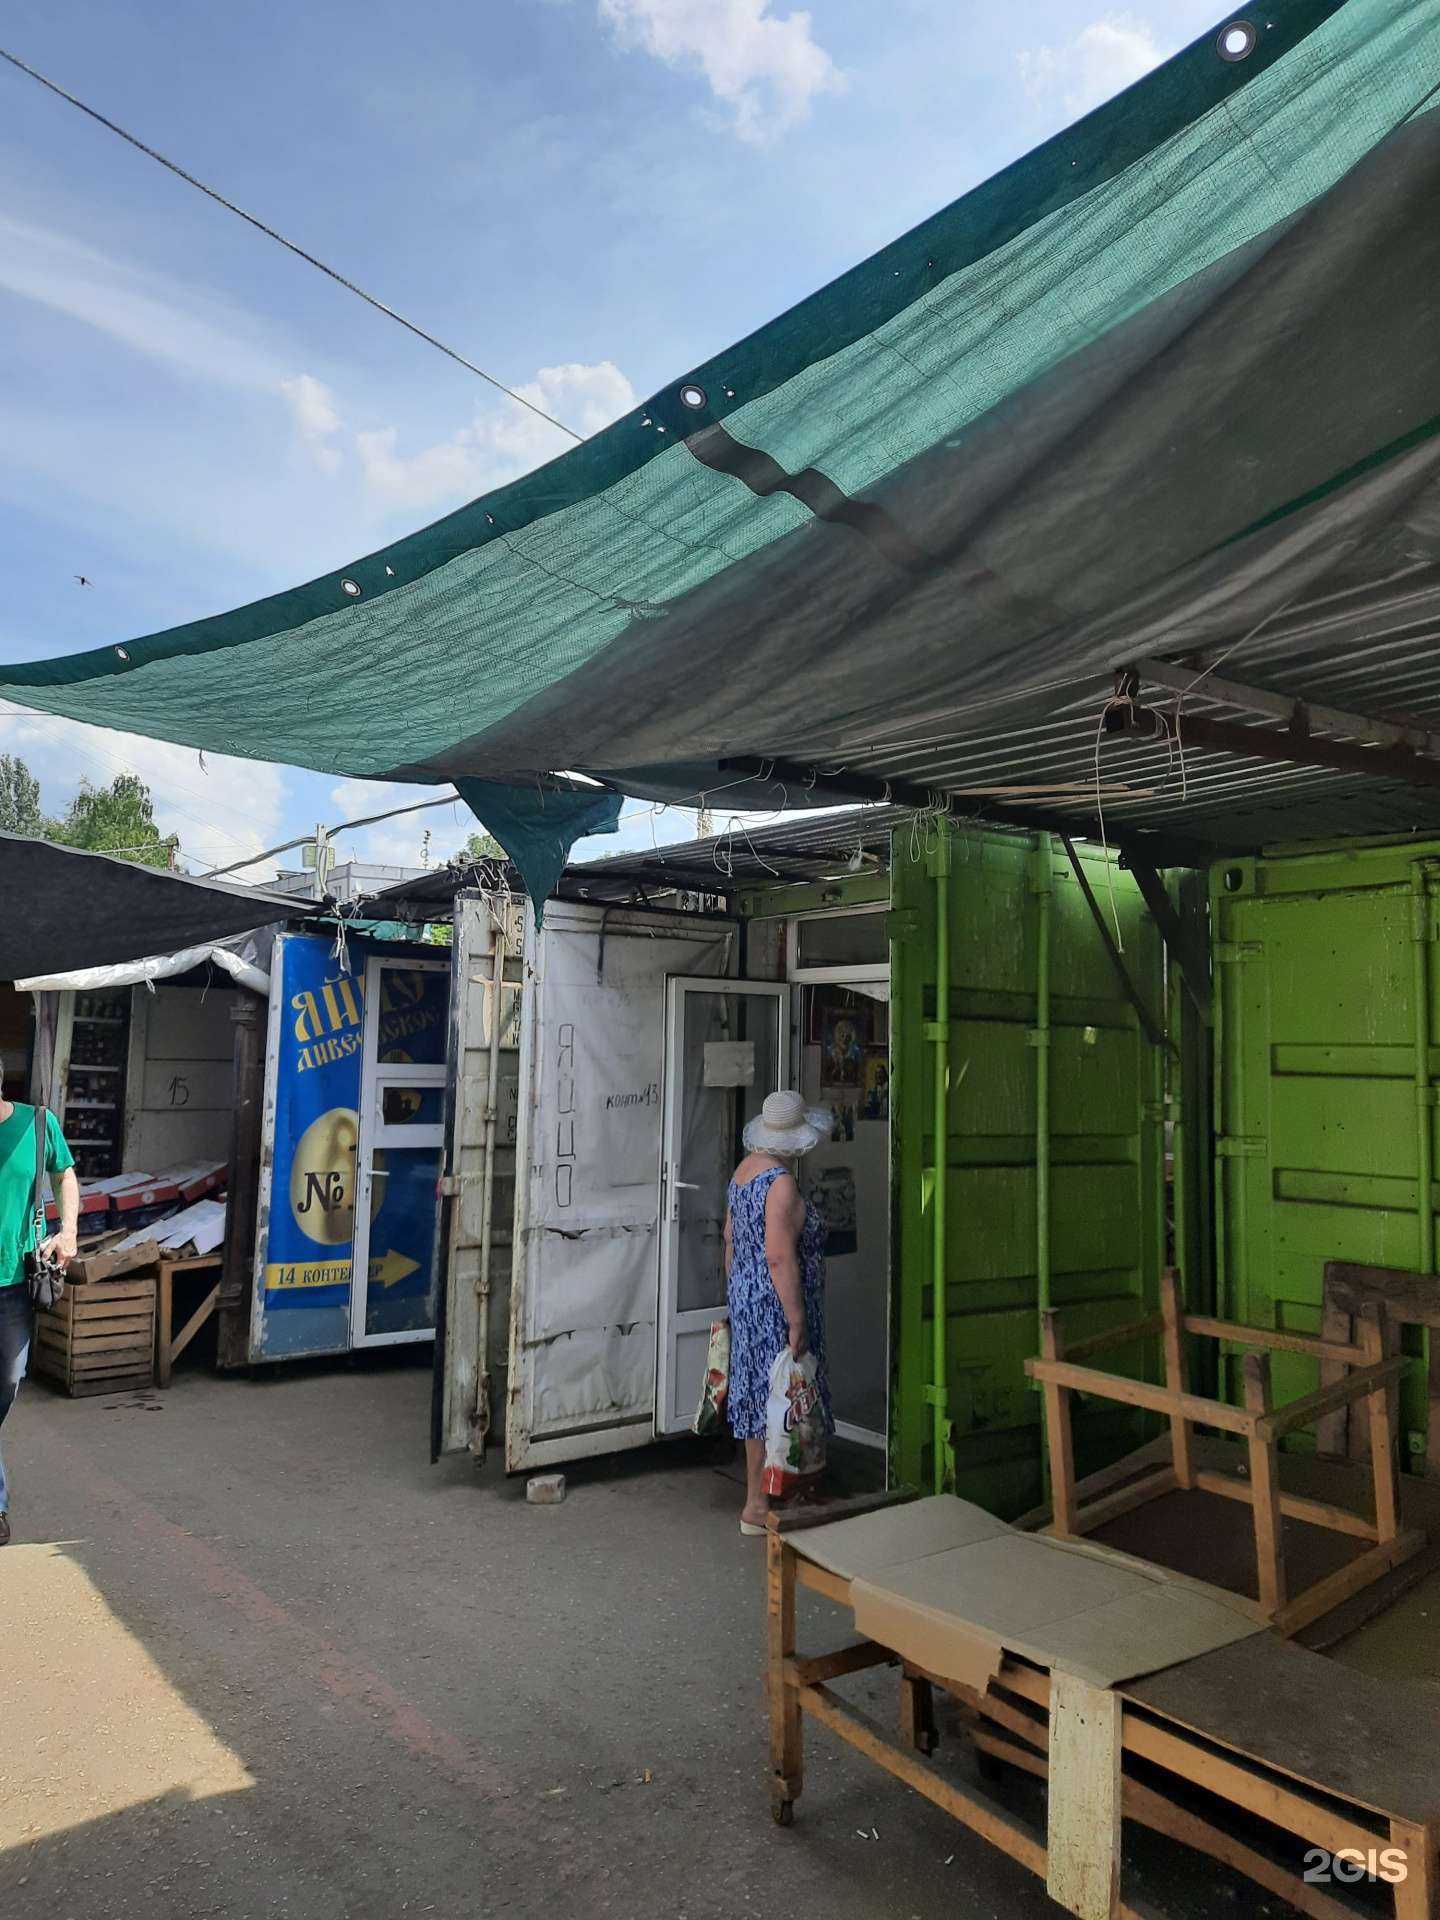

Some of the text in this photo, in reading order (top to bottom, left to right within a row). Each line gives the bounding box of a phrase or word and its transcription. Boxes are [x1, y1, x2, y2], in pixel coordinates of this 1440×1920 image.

[168, 1076, 190, 1106] 15
[278, 1263, 384, 1286] 14 КОНТЕЕР
